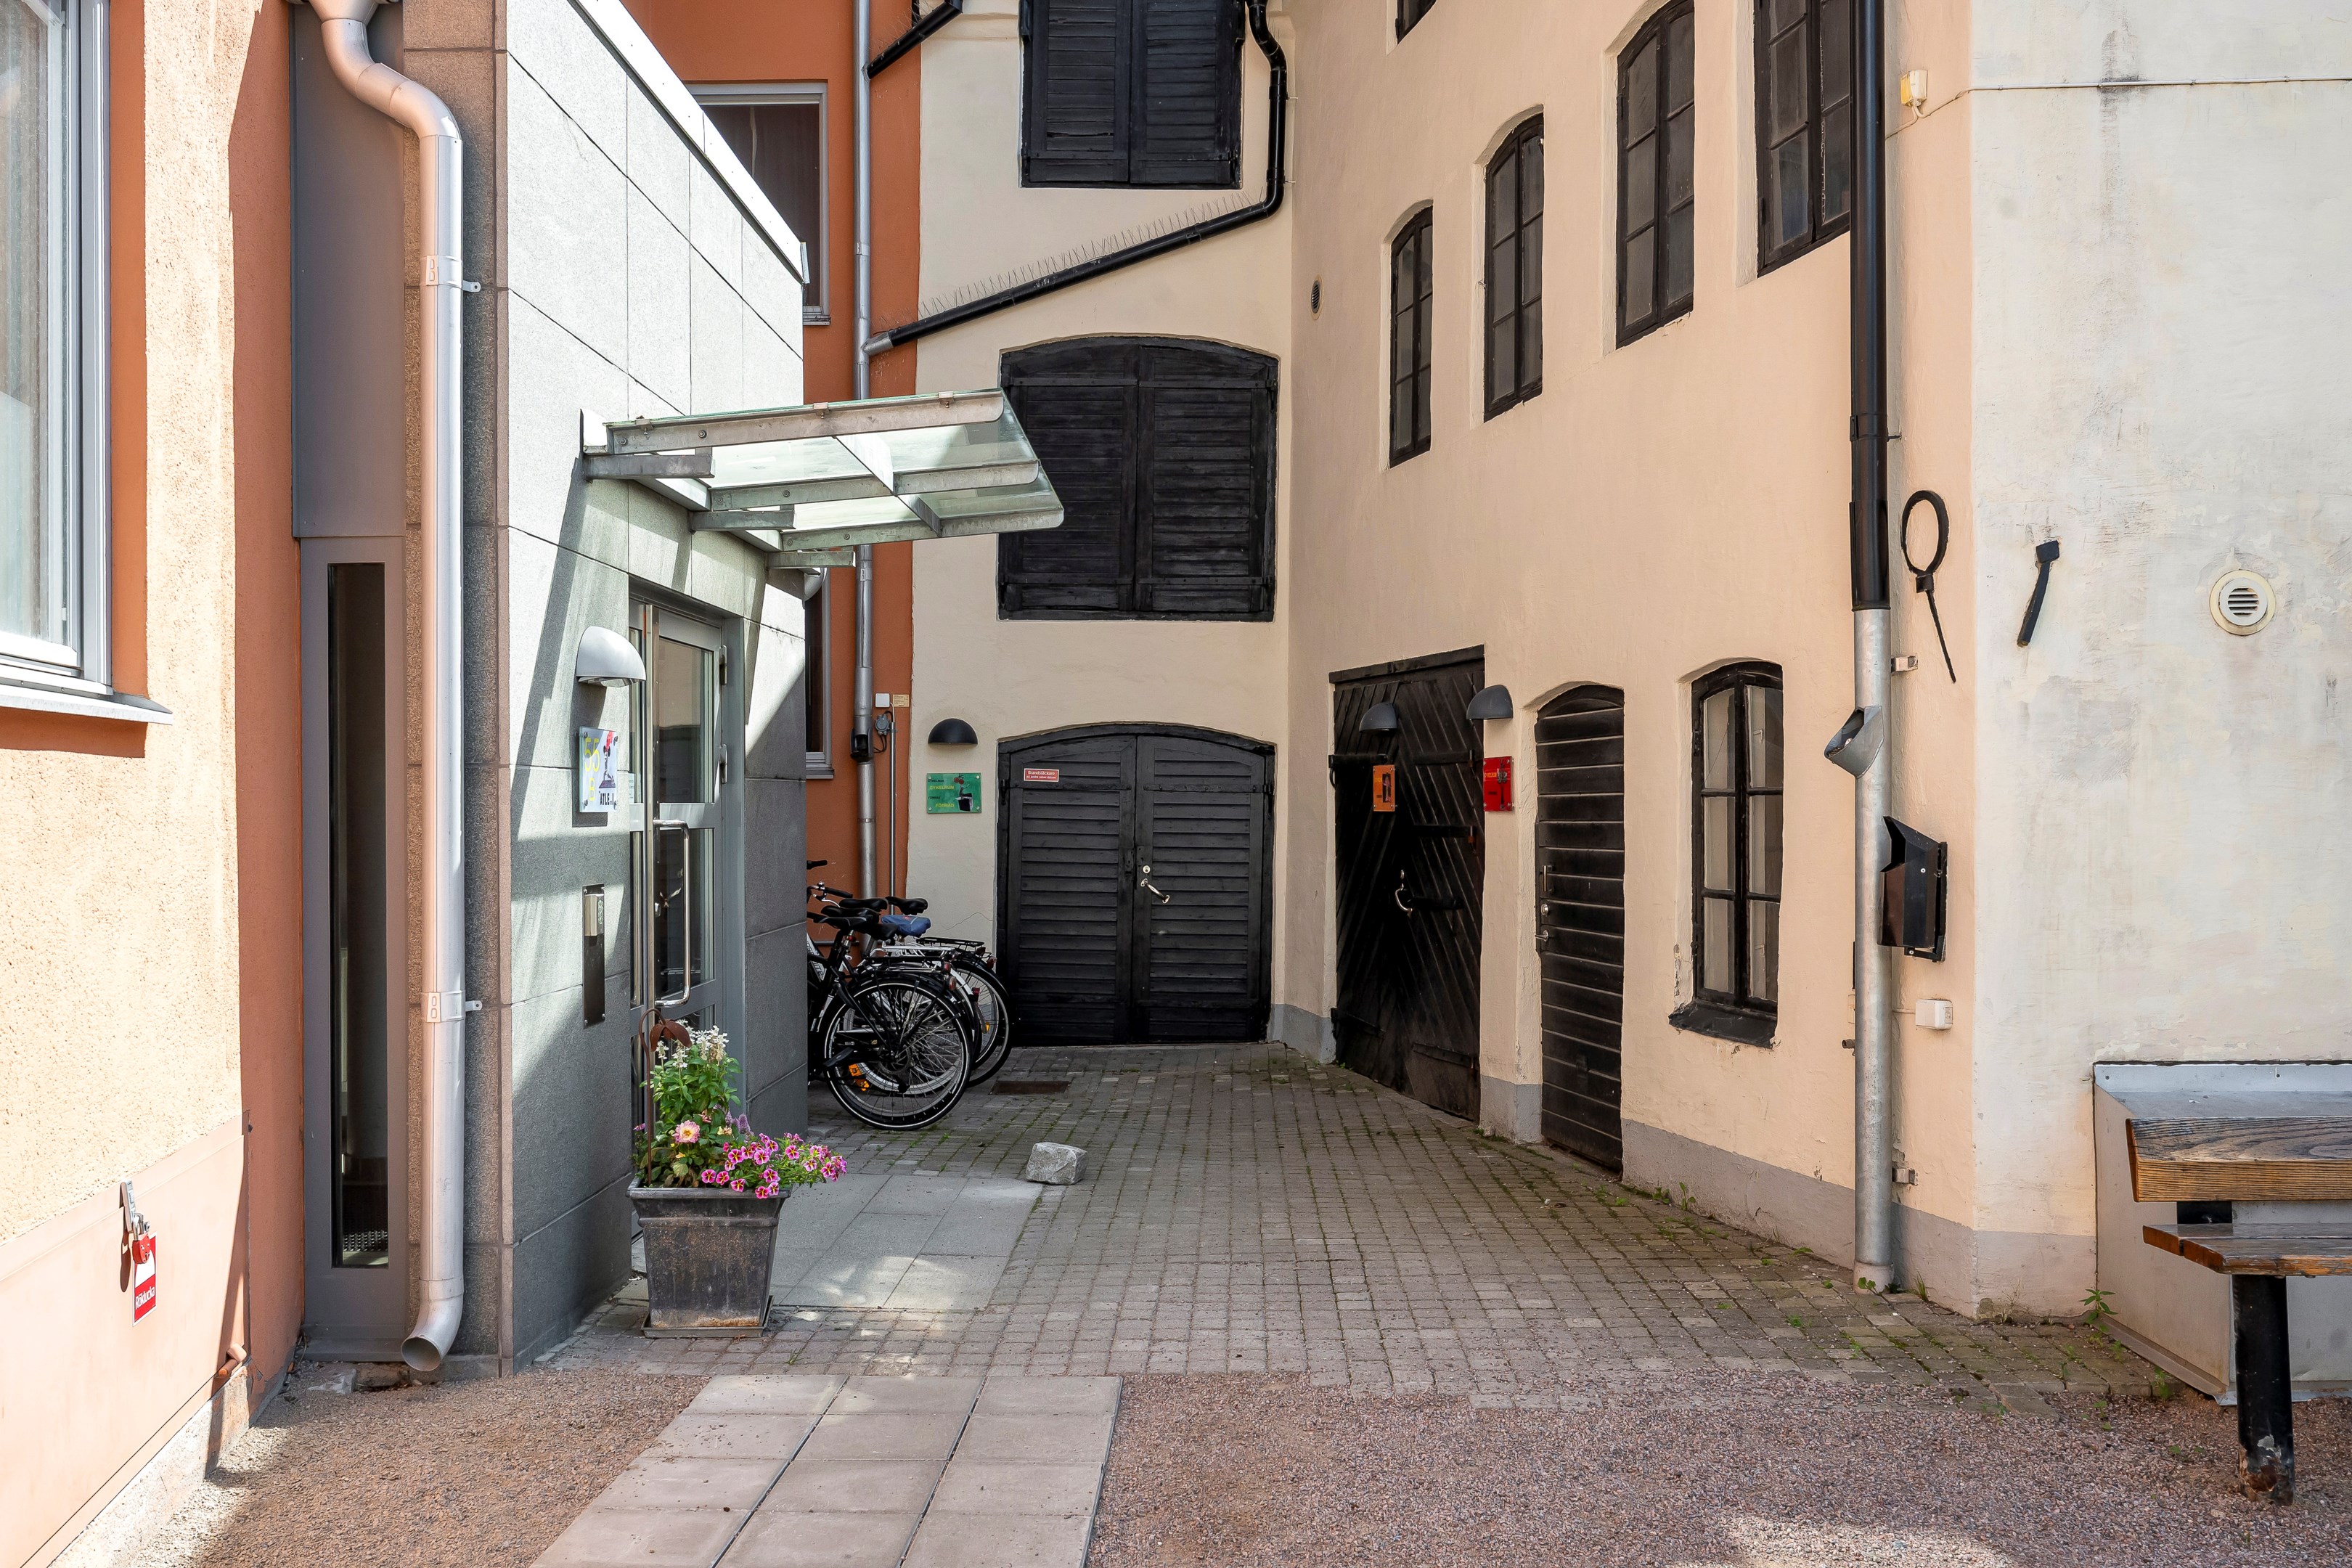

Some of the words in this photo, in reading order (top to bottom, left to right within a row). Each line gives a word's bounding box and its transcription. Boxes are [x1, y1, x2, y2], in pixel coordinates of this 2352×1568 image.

[584, 737, 600, 772] 55
[589, 777, 595, 801] B
[600, 793, 609, 805] ATLE
[135, 1286, 155, 1310] Röklucka
